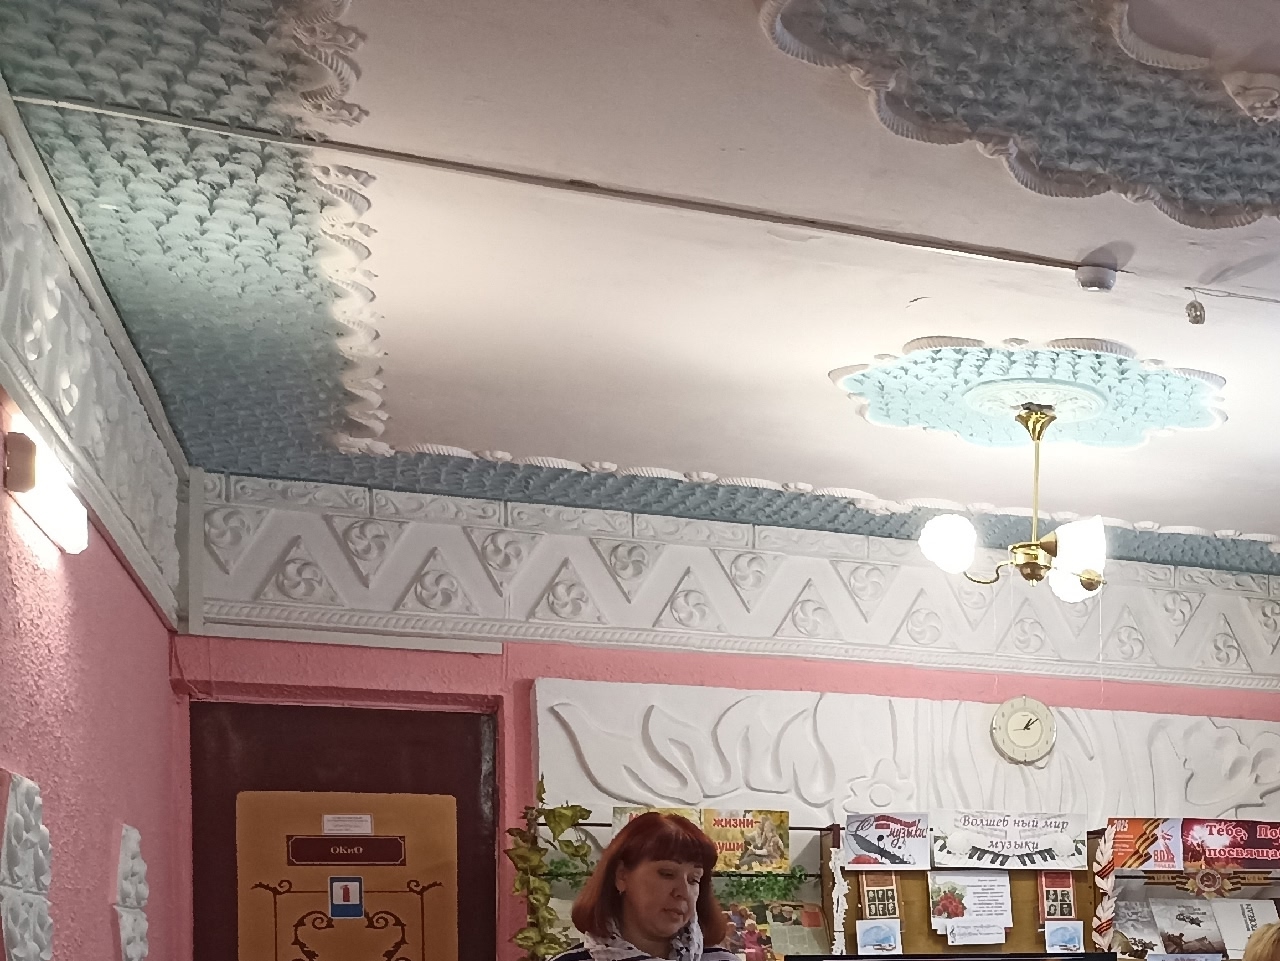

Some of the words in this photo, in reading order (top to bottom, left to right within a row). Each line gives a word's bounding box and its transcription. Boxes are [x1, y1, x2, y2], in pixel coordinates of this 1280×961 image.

[1041, 820, 1068, 833] мир
[1205, 822, 1248, 841] Тебе,
[988, 840, 1038, 853] музыки
